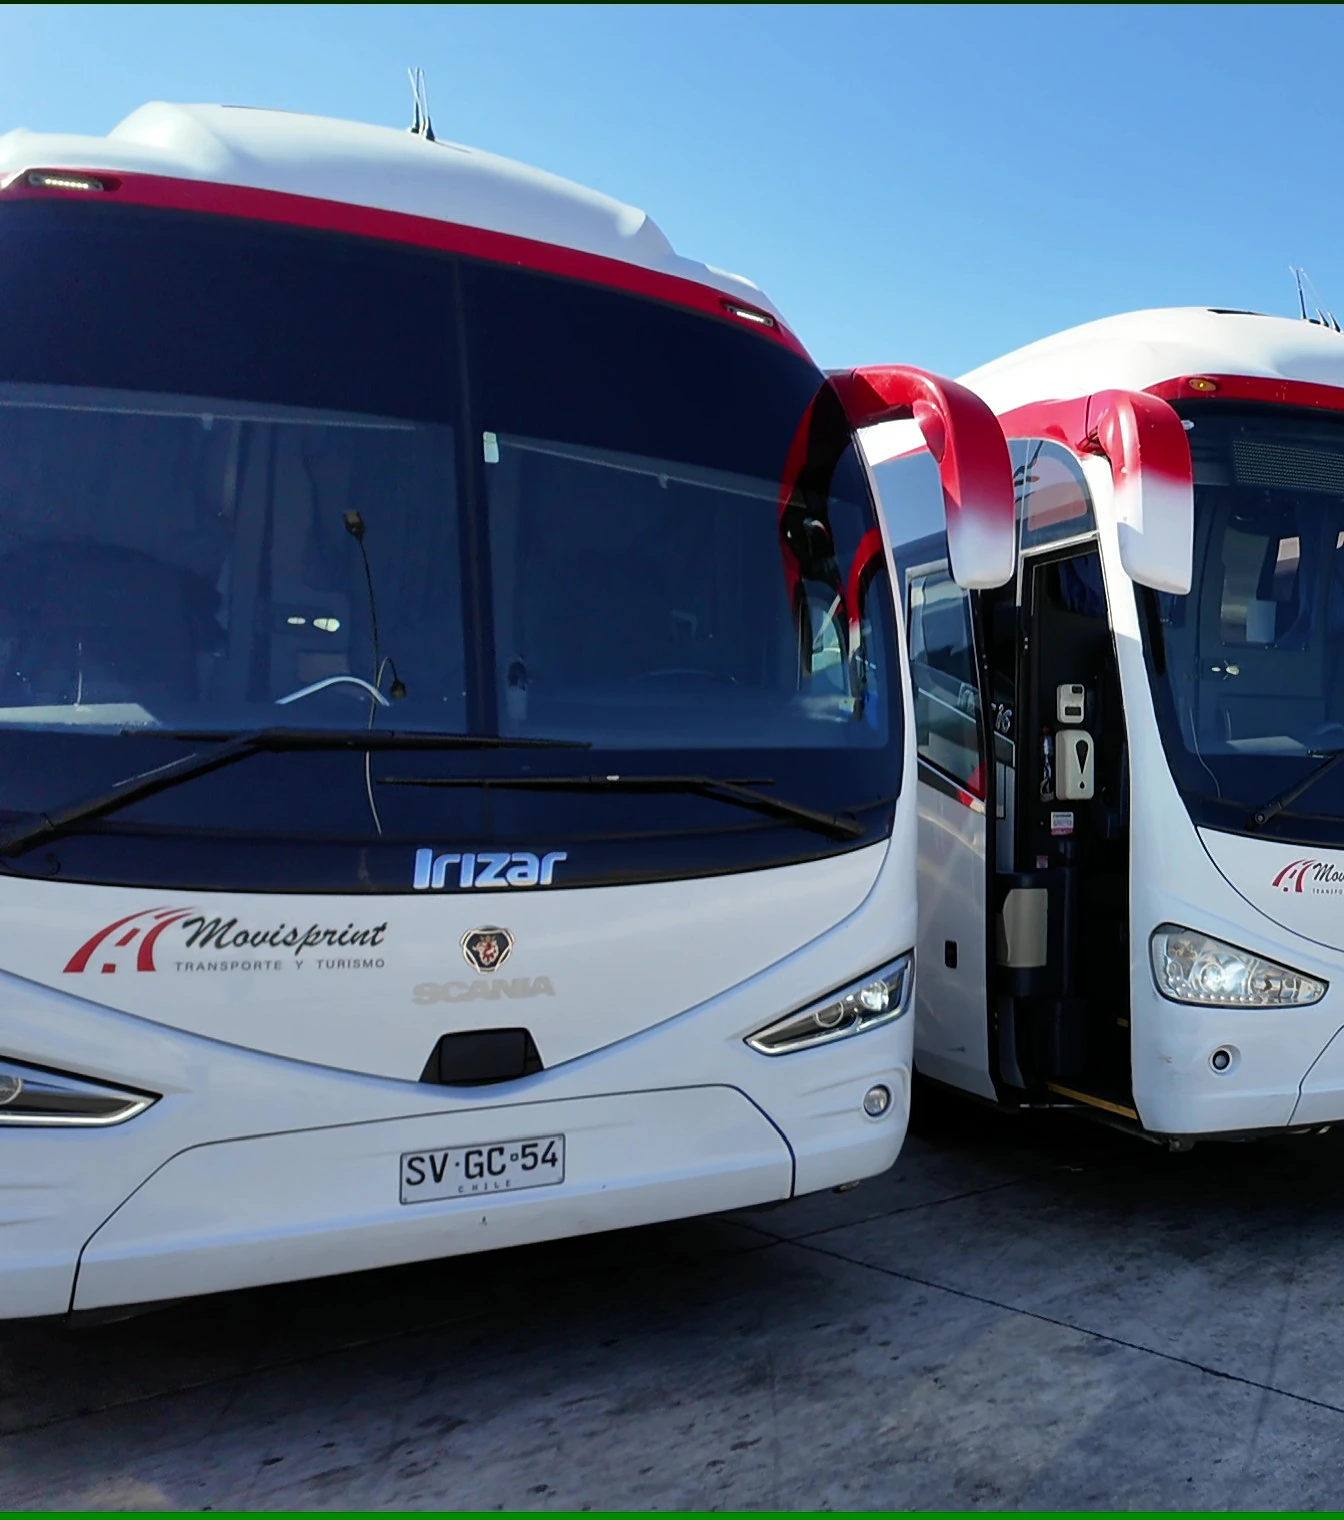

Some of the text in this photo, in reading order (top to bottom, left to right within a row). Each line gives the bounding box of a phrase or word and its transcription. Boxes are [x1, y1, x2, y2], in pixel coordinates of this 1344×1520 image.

[413, 848, 567, 889] Irizar
[182, 916, 388, 956] Movisprint
[175, 958, 385, 972] TRANSPORTE Y TURISMO
[412, 976, 556, 1005] SCANIA
[458, 1180, 511, 1193] CHILE
